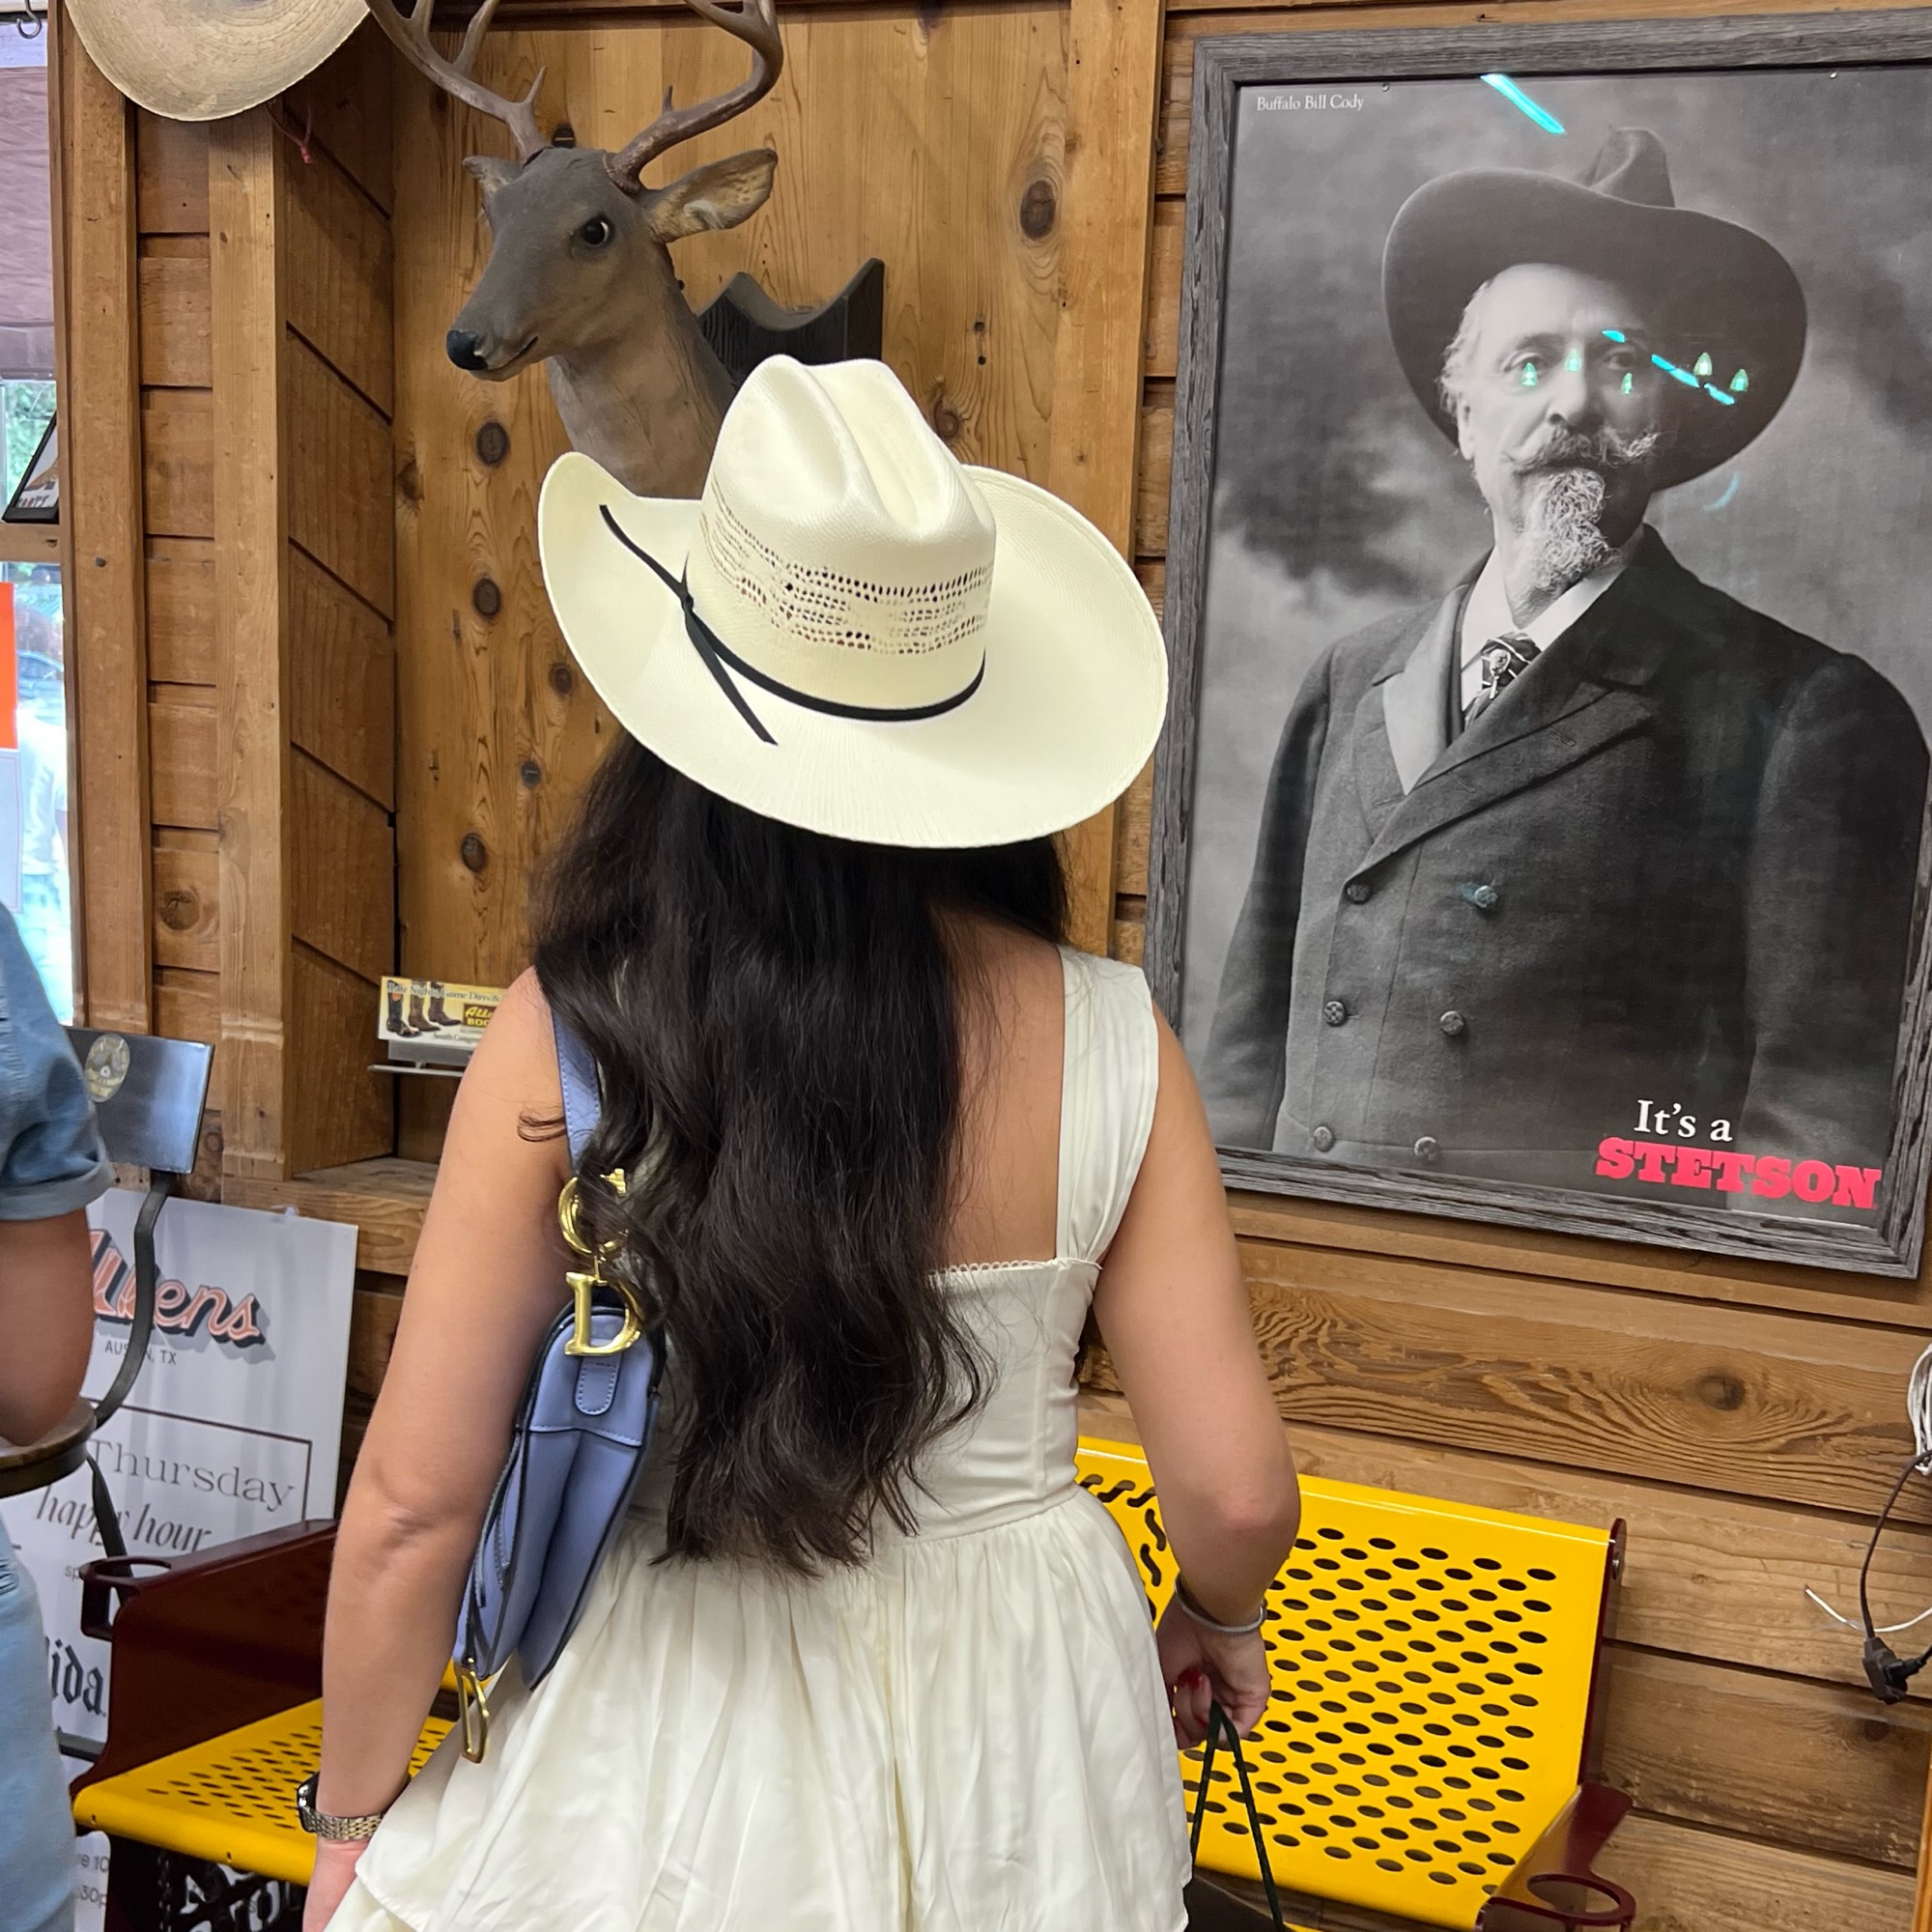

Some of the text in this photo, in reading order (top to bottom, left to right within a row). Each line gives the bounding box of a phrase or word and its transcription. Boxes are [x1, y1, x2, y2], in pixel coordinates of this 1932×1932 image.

[1257, 93, 1364, 111] Buffalo Bill Cody
[1634, 1099, 1732, 1142] It's a
[1596, 1136, 1882, 1208] STETSON
[160, 1349, 177, 1365] TX
[90, 1438, 295, 1512] Thursday
[133, 1503, 213, 1552] hour
